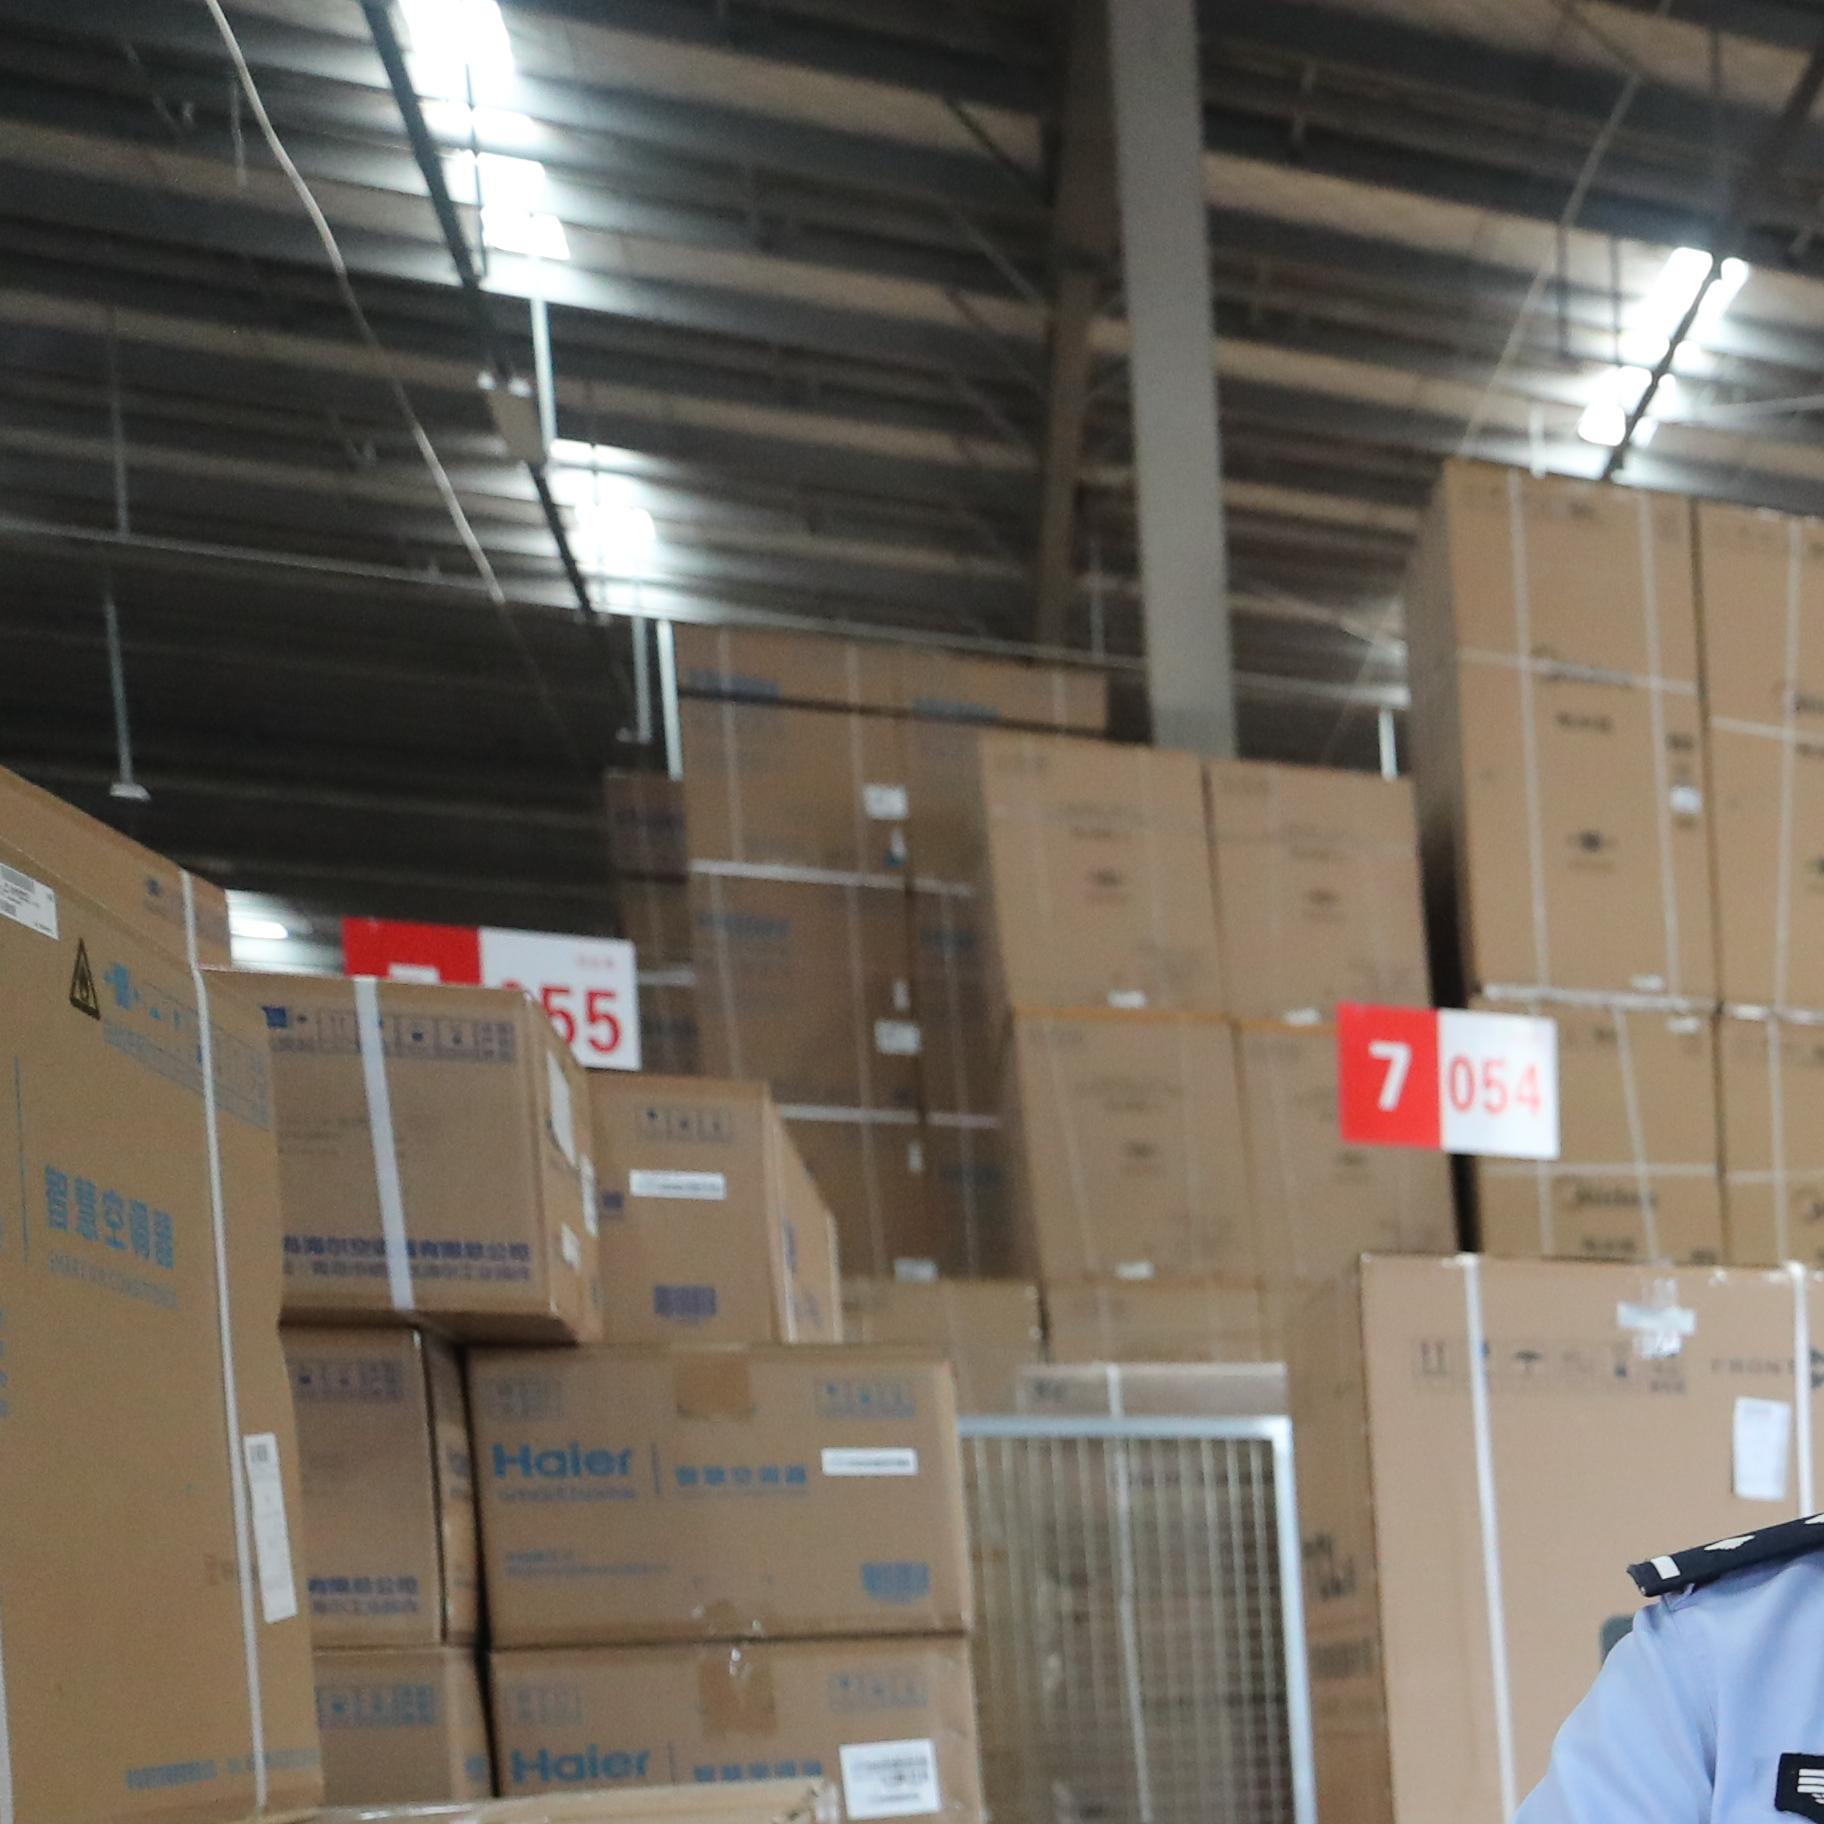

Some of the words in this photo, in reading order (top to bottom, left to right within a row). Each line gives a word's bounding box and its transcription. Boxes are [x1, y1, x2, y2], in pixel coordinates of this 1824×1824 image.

[503, 981, 622, 1056] 55
[1368, 1039, 1412, 1113] 7
[1449, 1054, 1542, 1116] 054
[492, 1440, 633, 1480] Haier
[510, 1741, 651, 1786] Haier
